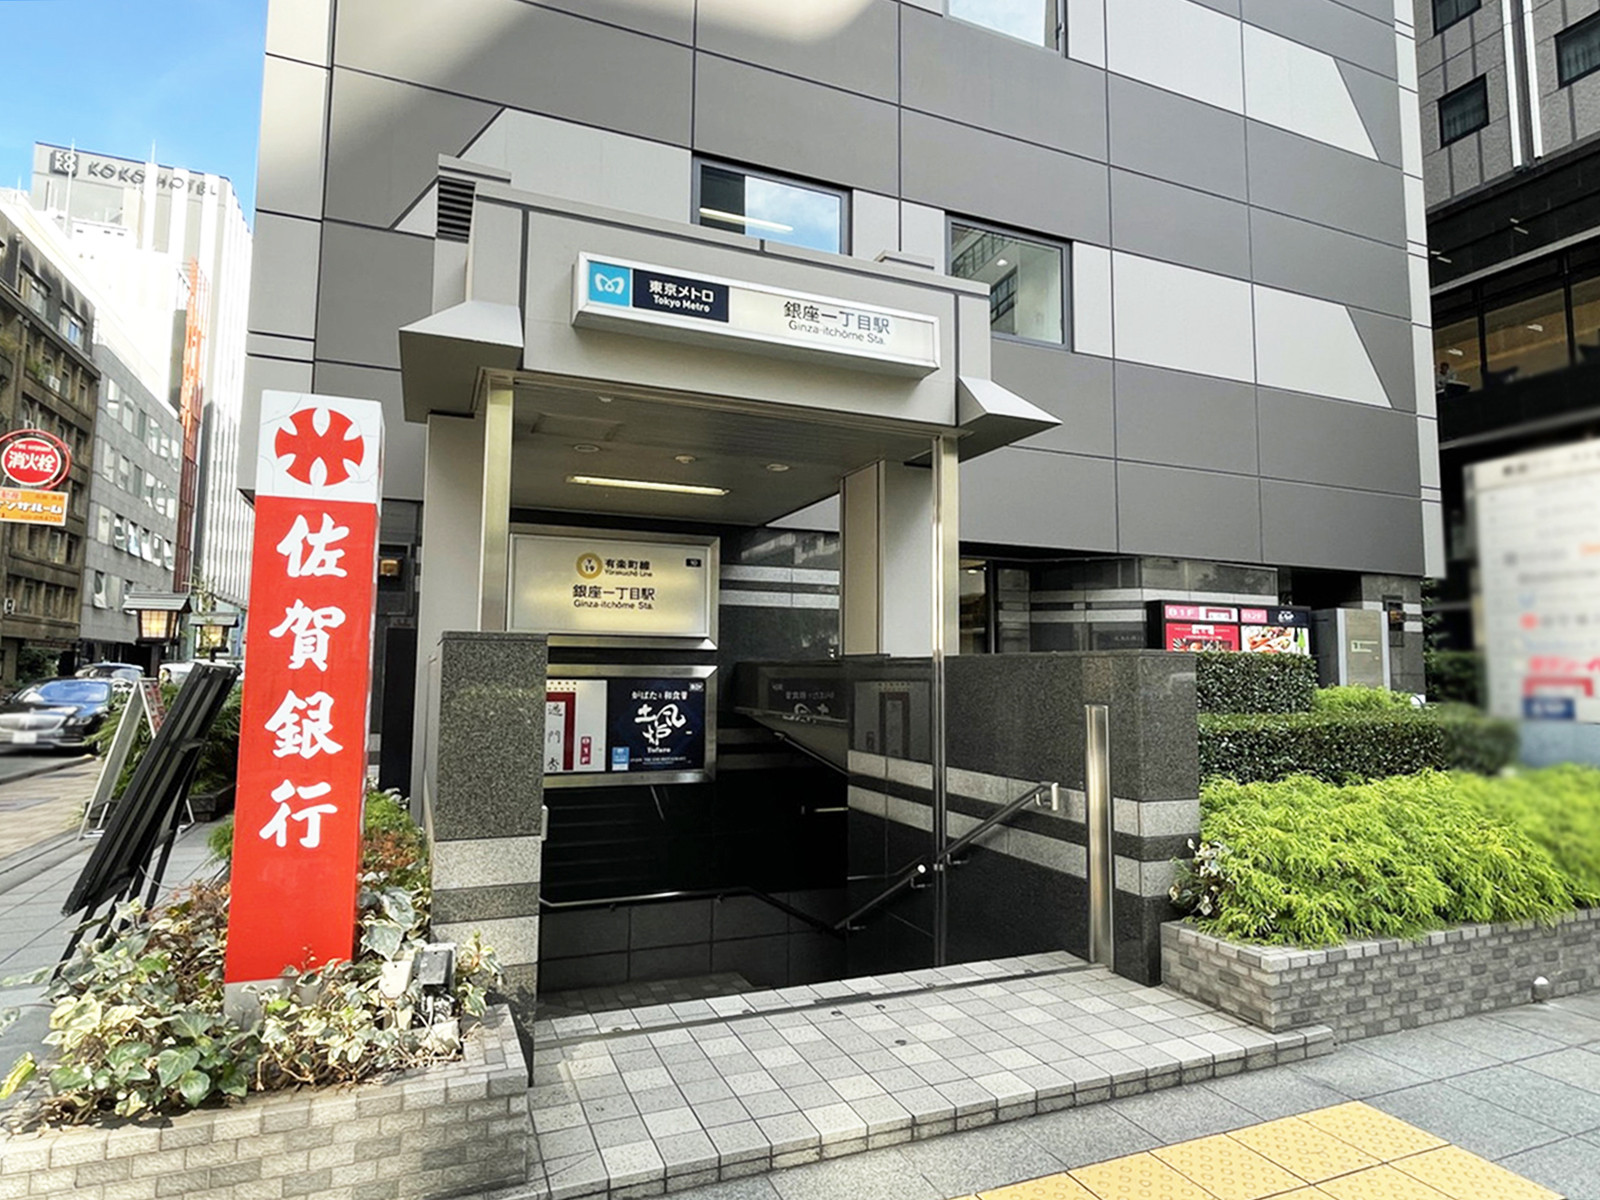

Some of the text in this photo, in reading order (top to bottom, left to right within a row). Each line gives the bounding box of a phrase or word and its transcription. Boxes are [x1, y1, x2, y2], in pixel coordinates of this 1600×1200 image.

[88, 161, 217, 196] KOKO HOTEL
[649, 279, 714, 303] 東京メトロ
[653, 294, 711, 313] Tokyo Metro
[783, 300, 891, 335] 銀座一丁目駅
[867, 332, 887, 345] Sta.
[7, 451, 55, 472] 消火栓
[604, 558, 651, 571] 有楽町線
[573, 584, 655, 601] 銀座一丁目駅
[258, 512, 348, 849] 佐賀銀行
